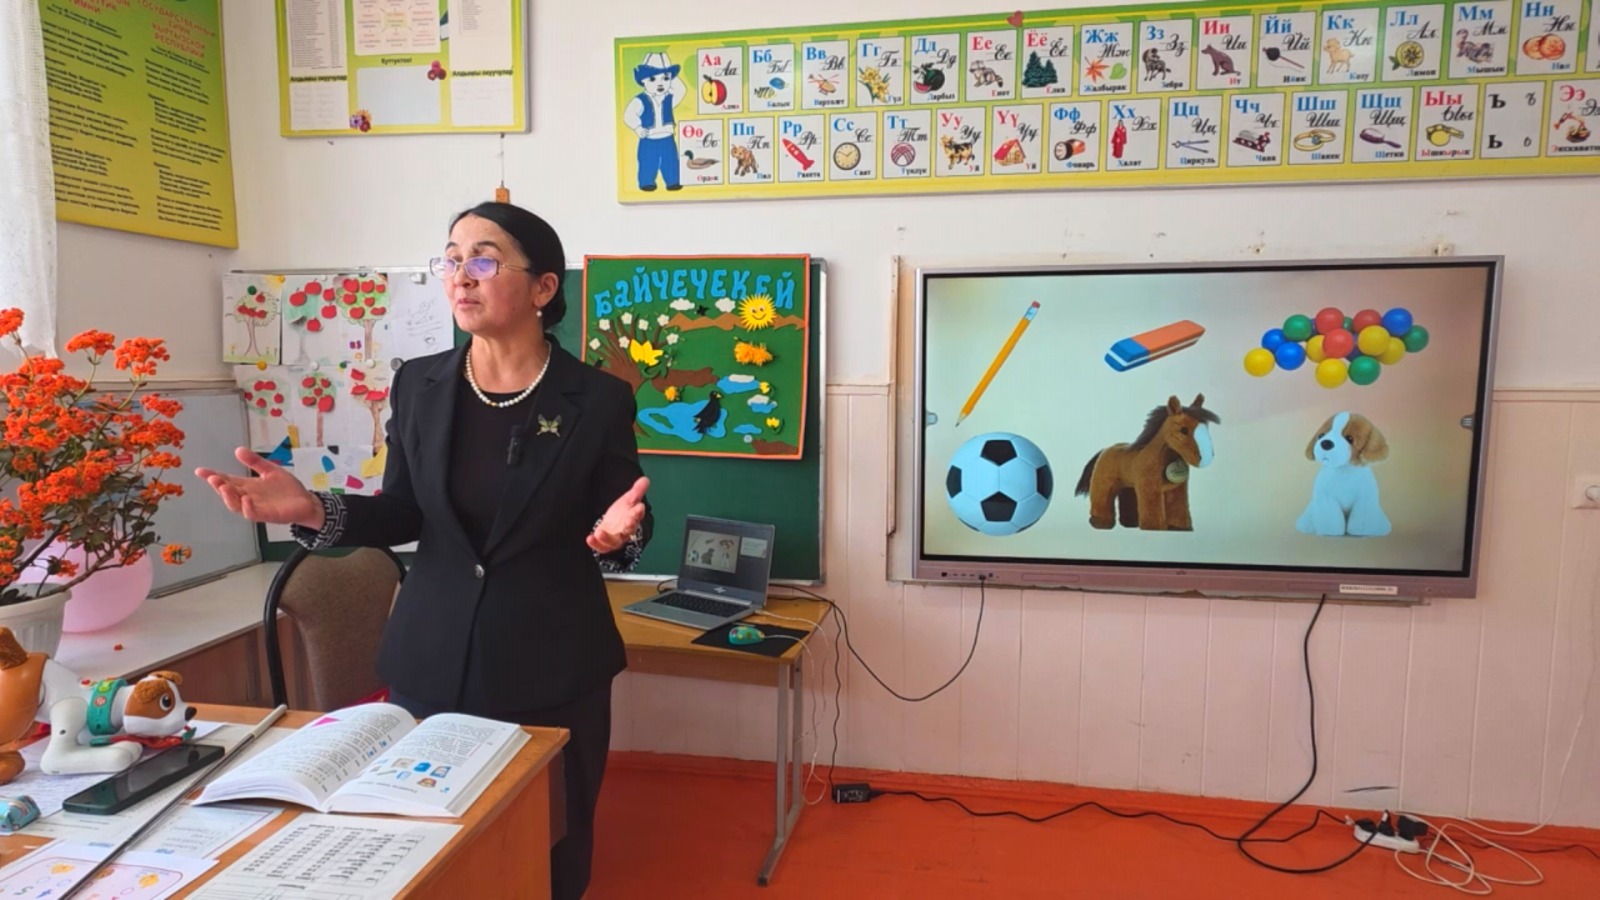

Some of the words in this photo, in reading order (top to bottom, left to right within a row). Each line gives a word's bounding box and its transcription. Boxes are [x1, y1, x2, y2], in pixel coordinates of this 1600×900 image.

[69, 0, 100, 13] ИМНИ
[1458, 6, 1493, 21] Мм
[1525, 2, 1554, 18] Нн
[1265, 16, 1292, 34] Йй
[1327, 15, 1355, 30] Кк
[1390, 11, 1418, 26] Лл
[1146, 26, 1164, 40] Зз
[1203, 20, 1230, 35] Ии
[973, 36, 992, 50] Ее
[1027, 29, 1047, 47] Ёё
[1085, 29, 1119, 43] Жж
[806, 47, 827, 60] Вв
[862, 43, 882, 57] Гг
[914, 38, 937, 55] Дд
[701, 53, 722, 67] Аа
[753, 50, 772, 63] Бб
[1424, 91, 1462, 106] Ыы
[1560, 85, 1585, 102] Ээ
[1235, 99, 1260, 113] Чч
[1297, 97, 1337, 110] Шш
[1361, 94, 1401, 110] Щщ
[1489, 94, 1506, 109] Ъ
[1054, 107, 1080, 123] Фф
[1113, 105, 1135, 119] Хх
[1172, 102, 1199, 117] Цц
[833, 119, 854, 131] Сс
[887, 115, 908, 129] Тт
[941, 113, 962, 130] Уу
[997, 110, 1019, 128] Үү
[732, 123, 755, 136] Пп
[783, 121, 803, 135] Рр
[1488, 135, 1502, 149] Ь
